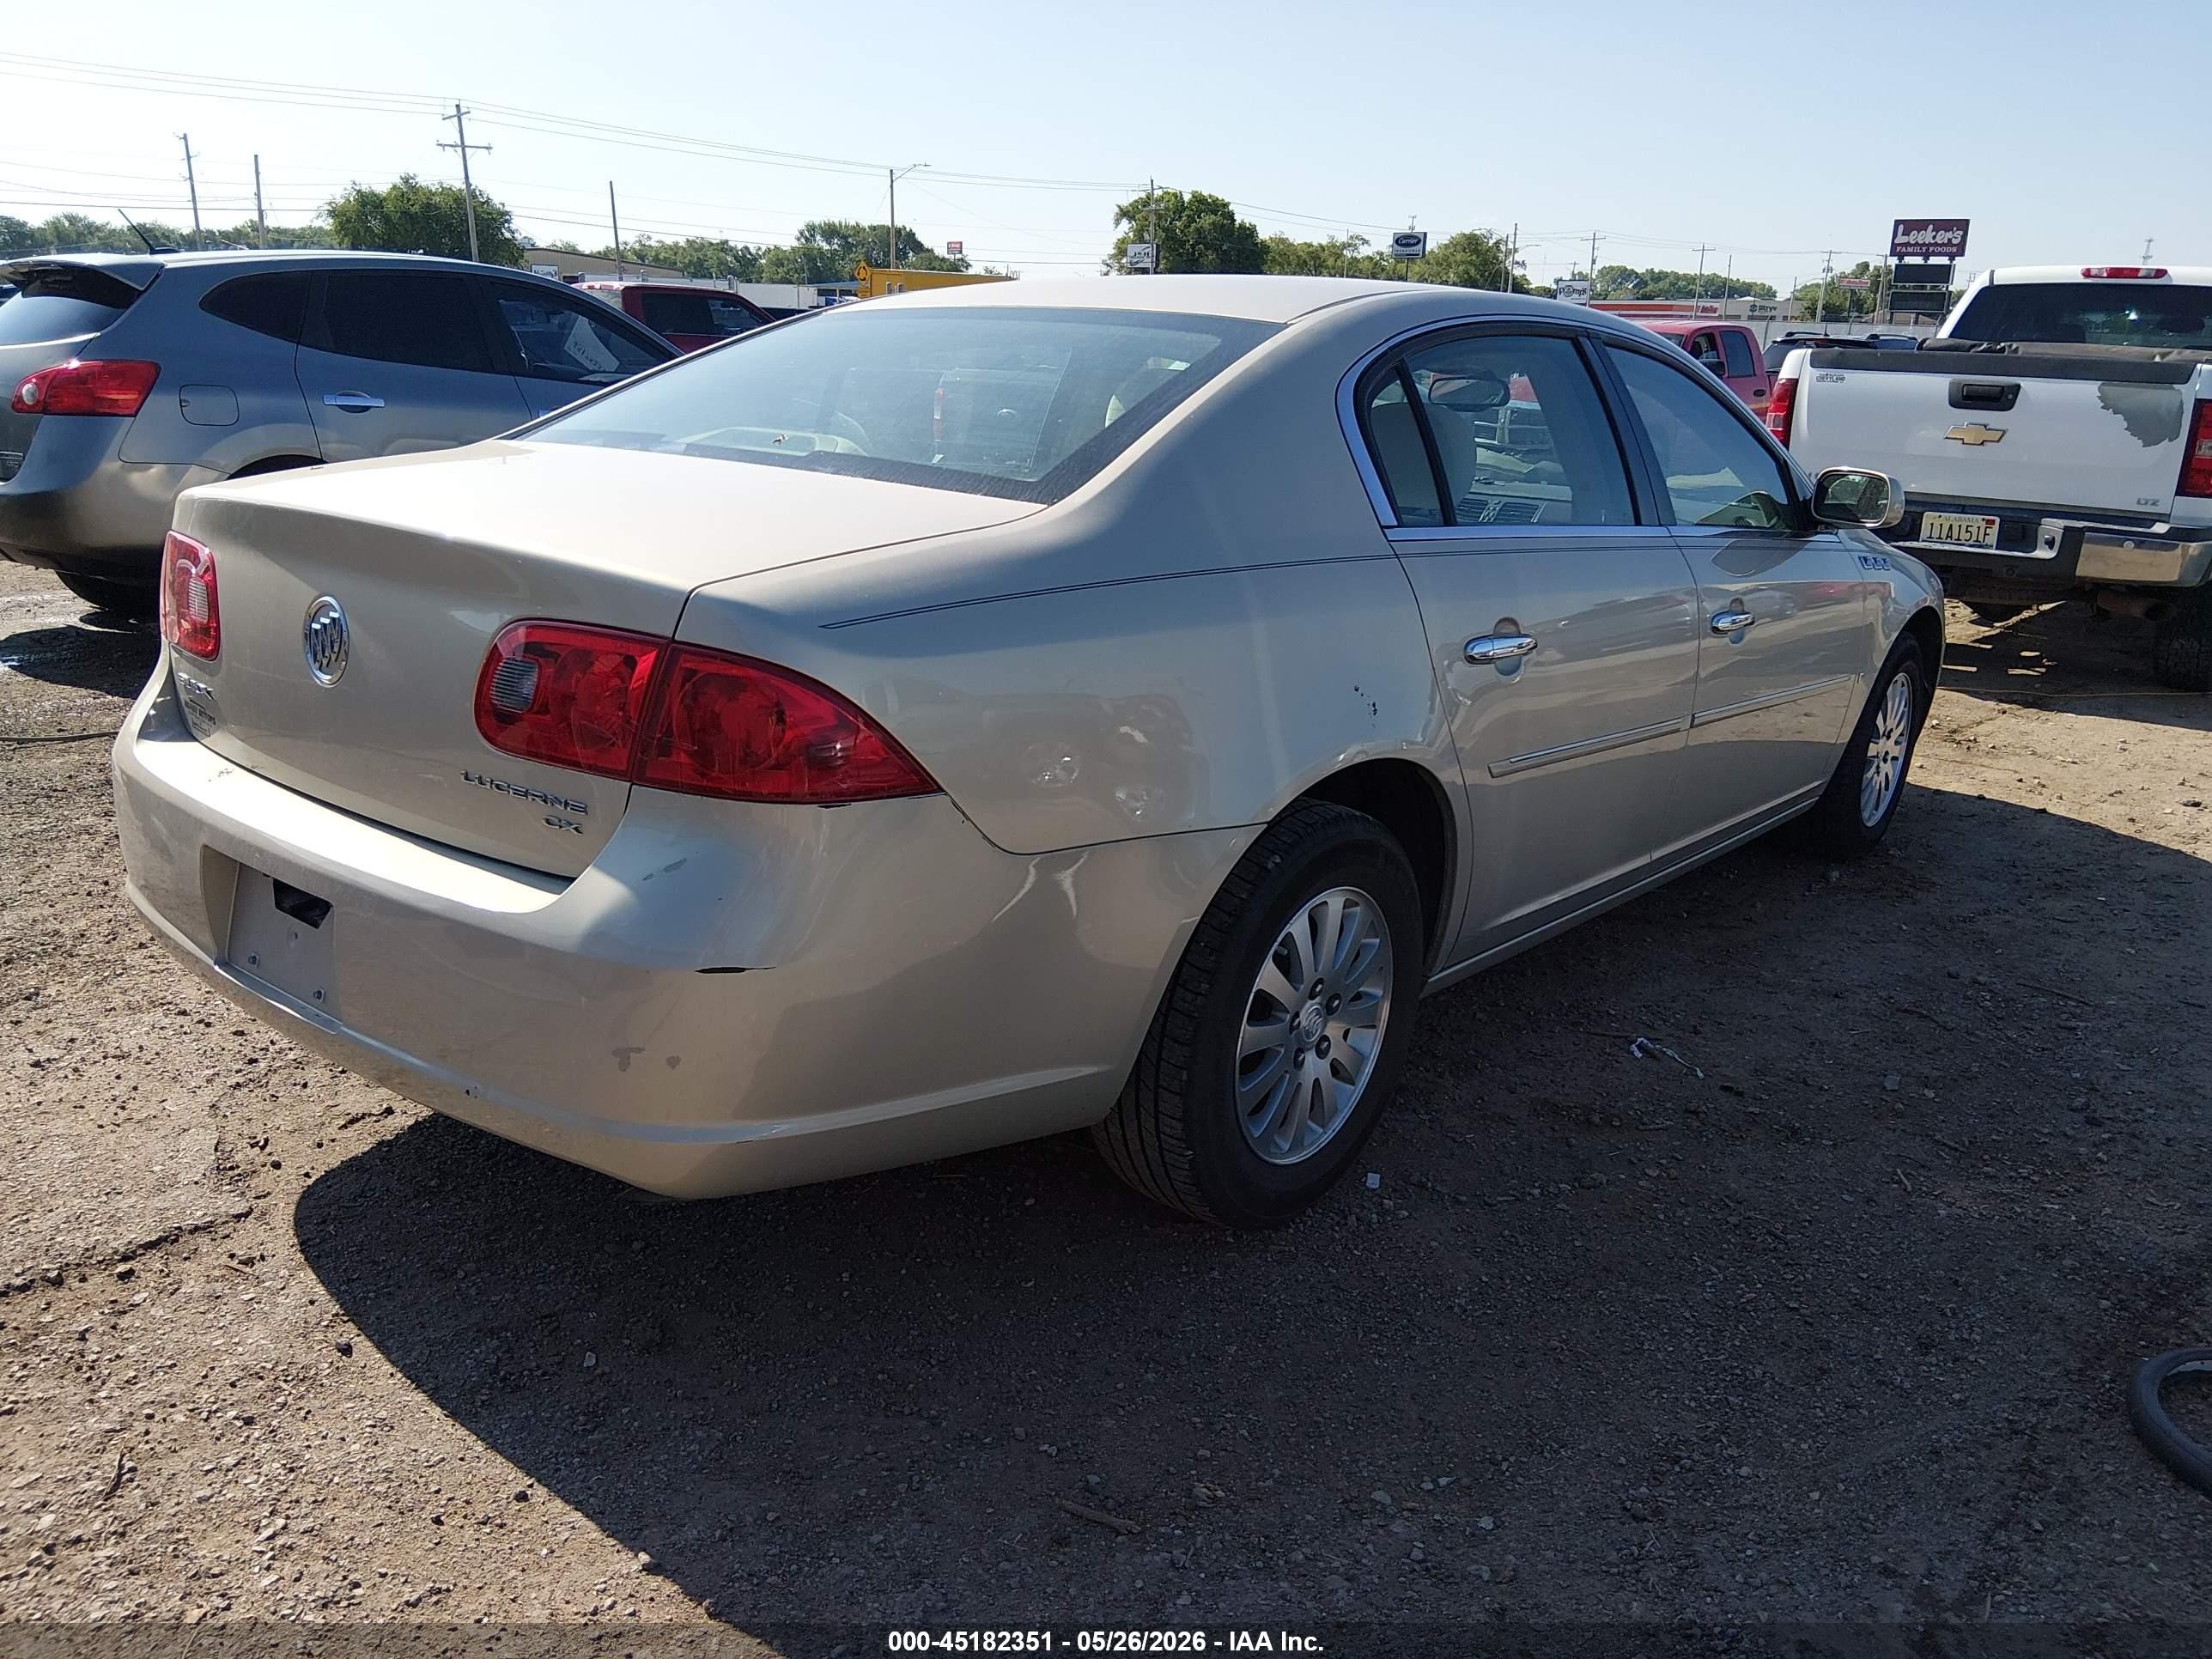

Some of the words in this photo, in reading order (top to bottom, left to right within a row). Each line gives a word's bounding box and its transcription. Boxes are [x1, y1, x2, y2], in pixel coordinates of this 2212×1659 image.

[1894, 224, 1964, 244] Leeker's
[2136, 498, 2160, 507] LTZ
[1926, 522, 1994, 544] 11A151F
[460, 770, 588, 816] LUCERNE
[542, 815, 583, 836] CX
